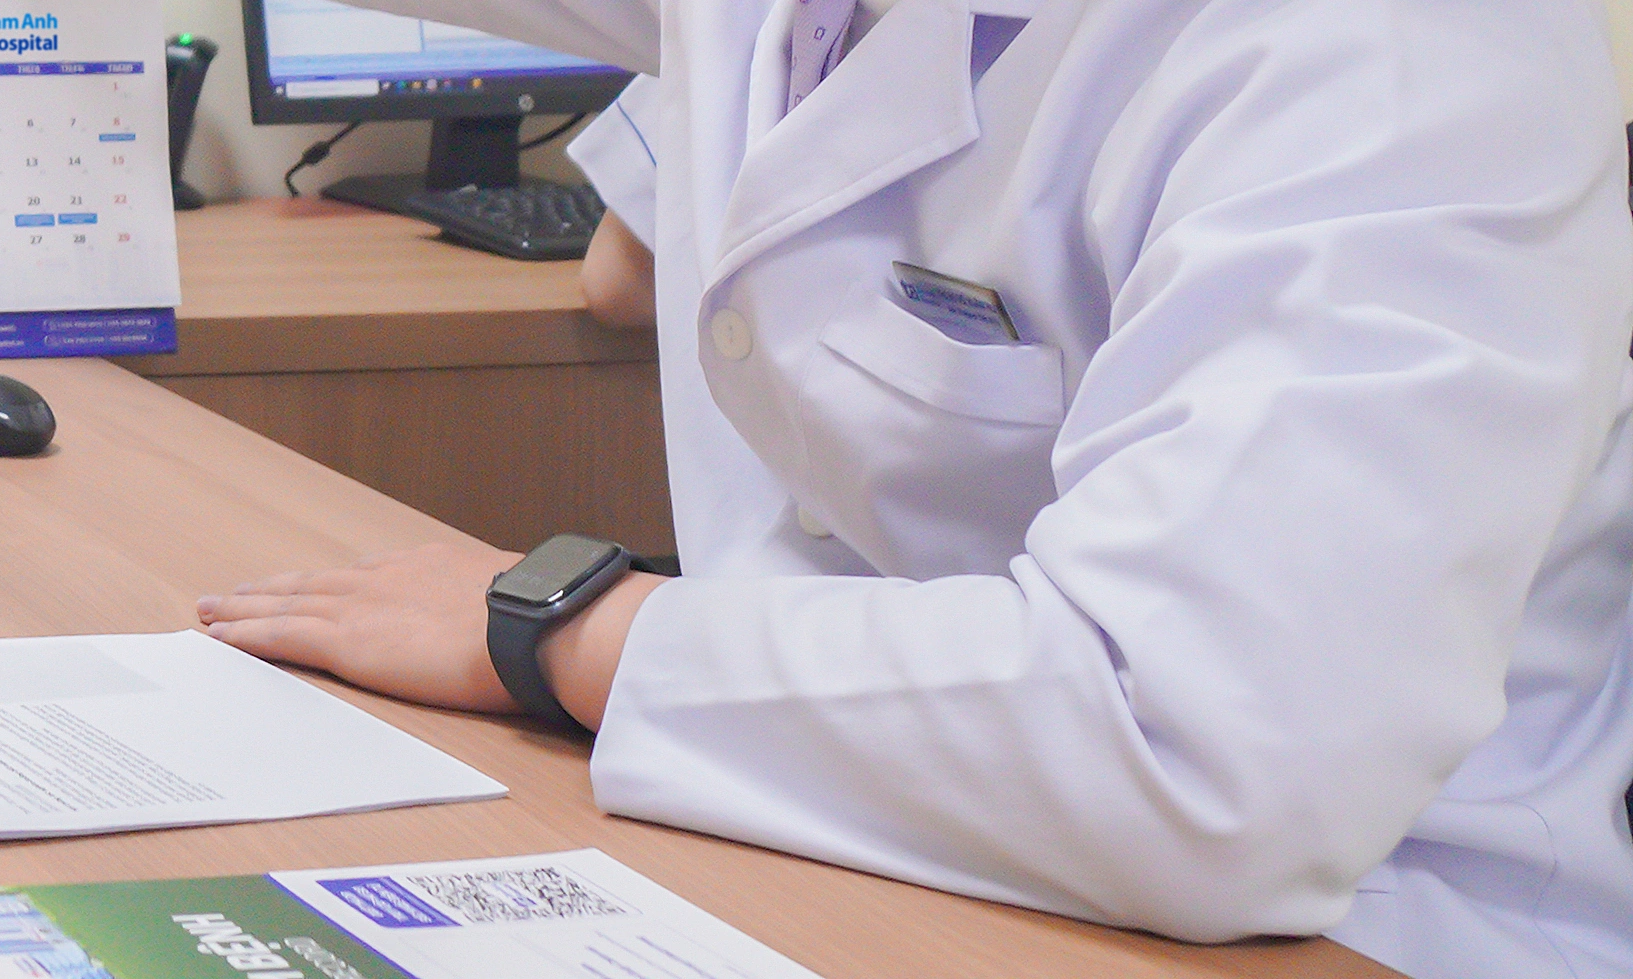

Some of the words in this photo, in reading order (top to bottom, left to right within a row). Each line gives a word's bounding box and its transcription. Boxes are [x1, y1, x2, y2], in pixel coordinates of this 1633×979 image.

[21, 13, 58, 30] Anh
[70, 117, 77, 127] 7
[26, 157, 39, 167] 13
[68, 156, 82, 166] 14
[27, 196, 41, 207] 20
[114, 194, 128, 205] 22
[30, 235, 43, 245] 27
[171, 913, 291, 971] BỆNH
